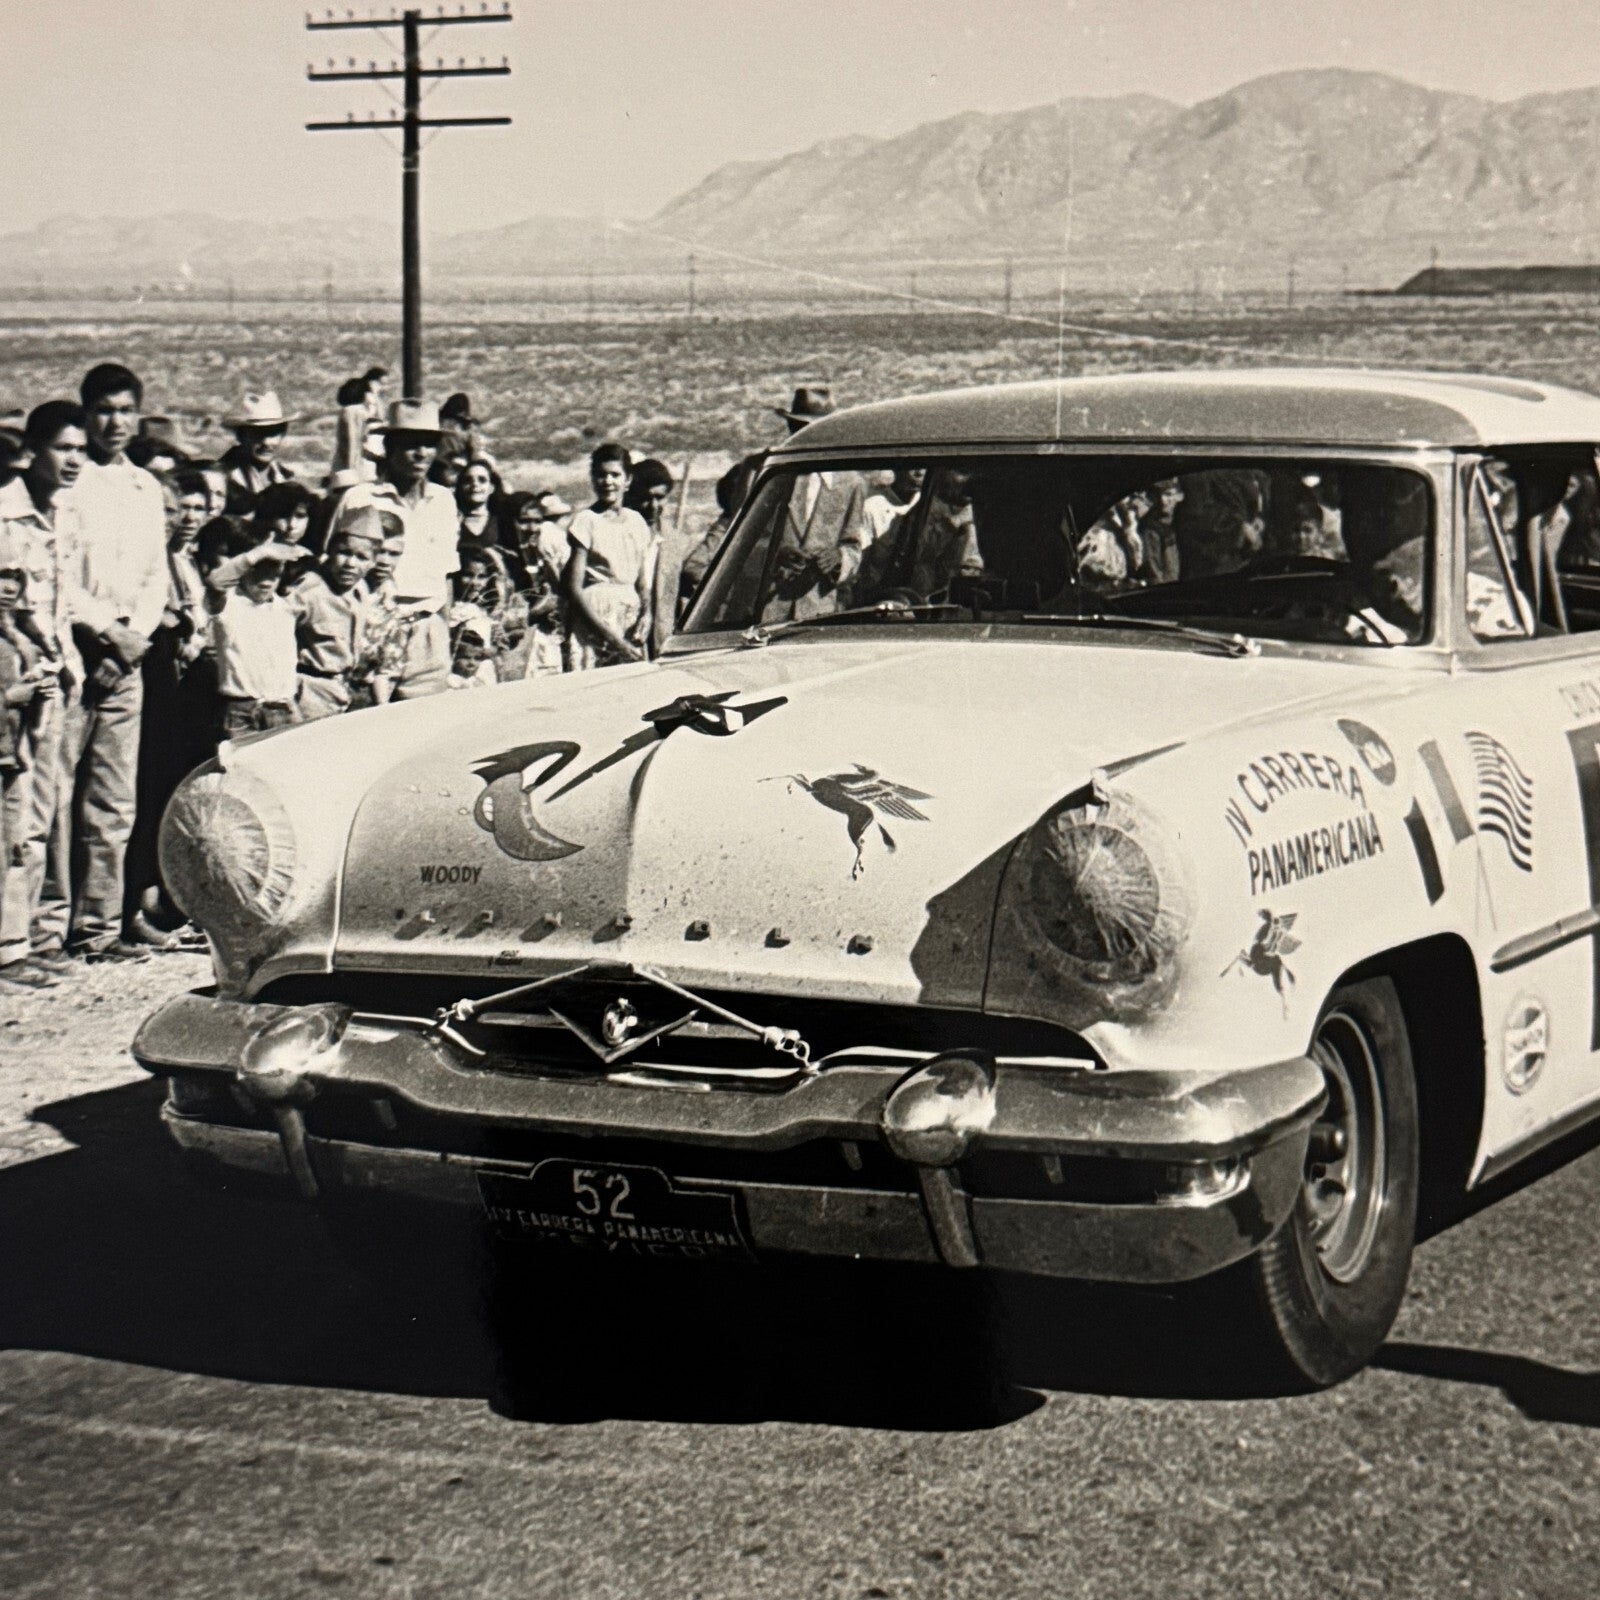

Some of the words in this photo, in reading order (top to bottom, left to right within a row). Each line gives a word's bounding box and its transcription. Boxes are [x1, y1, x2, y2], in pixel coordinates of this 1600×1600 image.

[1237, 752, 1367, 813] CARRERA
[1224, 797, 1253, 849] IV
[420, 865, 483, 885] WOODY
[1247, 811, 1384, 896] PANAMERICANA
[573, 1168, 635, 1220] 52
[516, 1208, 597, 1235] CARRERA
[603, 1220, 740, 1247] PANAMERICANA
